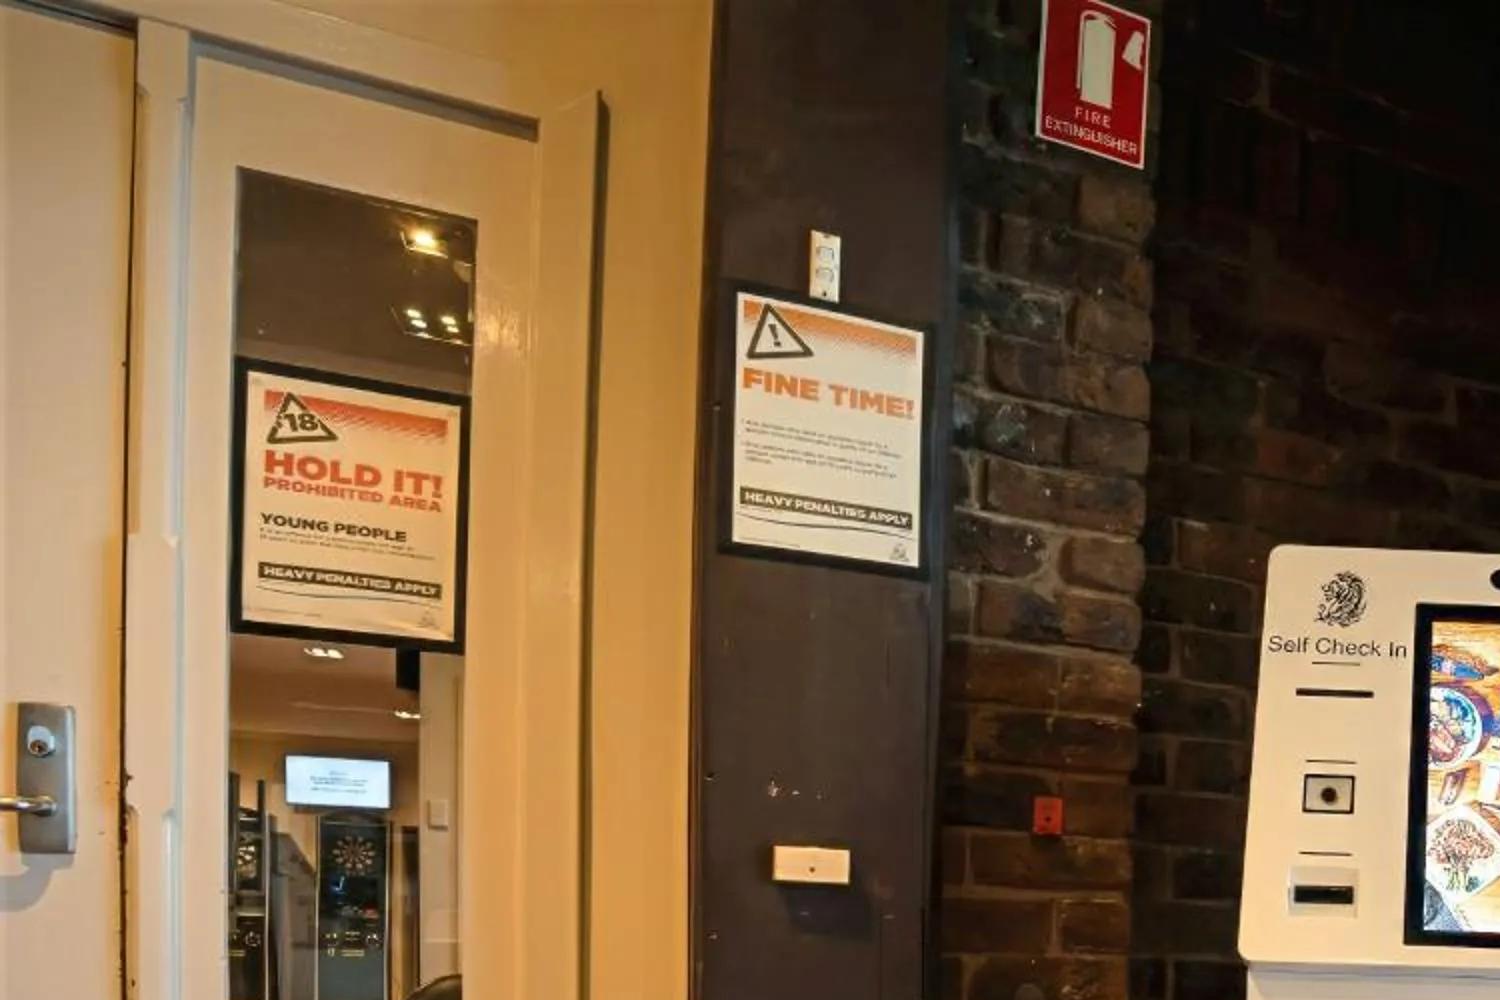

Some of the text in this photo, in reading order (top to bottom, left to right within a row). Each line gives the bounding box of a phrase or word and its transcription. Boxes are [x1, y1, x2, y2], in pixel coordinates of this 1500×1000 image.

[1075, 106, 1111, 128] FIRE
[1045, 116, 1137, 155] EXTINGUISHER
[741, 368, 915, 421] FINE TIME!
[283, 412, 319, 433] 18
[263, 450, 443, 499] HOLD IT!
[263, 476, 442, 513] PROHIBITED AREA
[745, 491, 910, 527] HEAVY PENALTIES APPLY
[261, 512, 329, 533] YOUNG
[334, 523, 407, 543] PEOPLE
[264, 566, 437, 596] HEAVY PENALTIES APPLY
[1268, 635, 1407, 658] Self Check In
